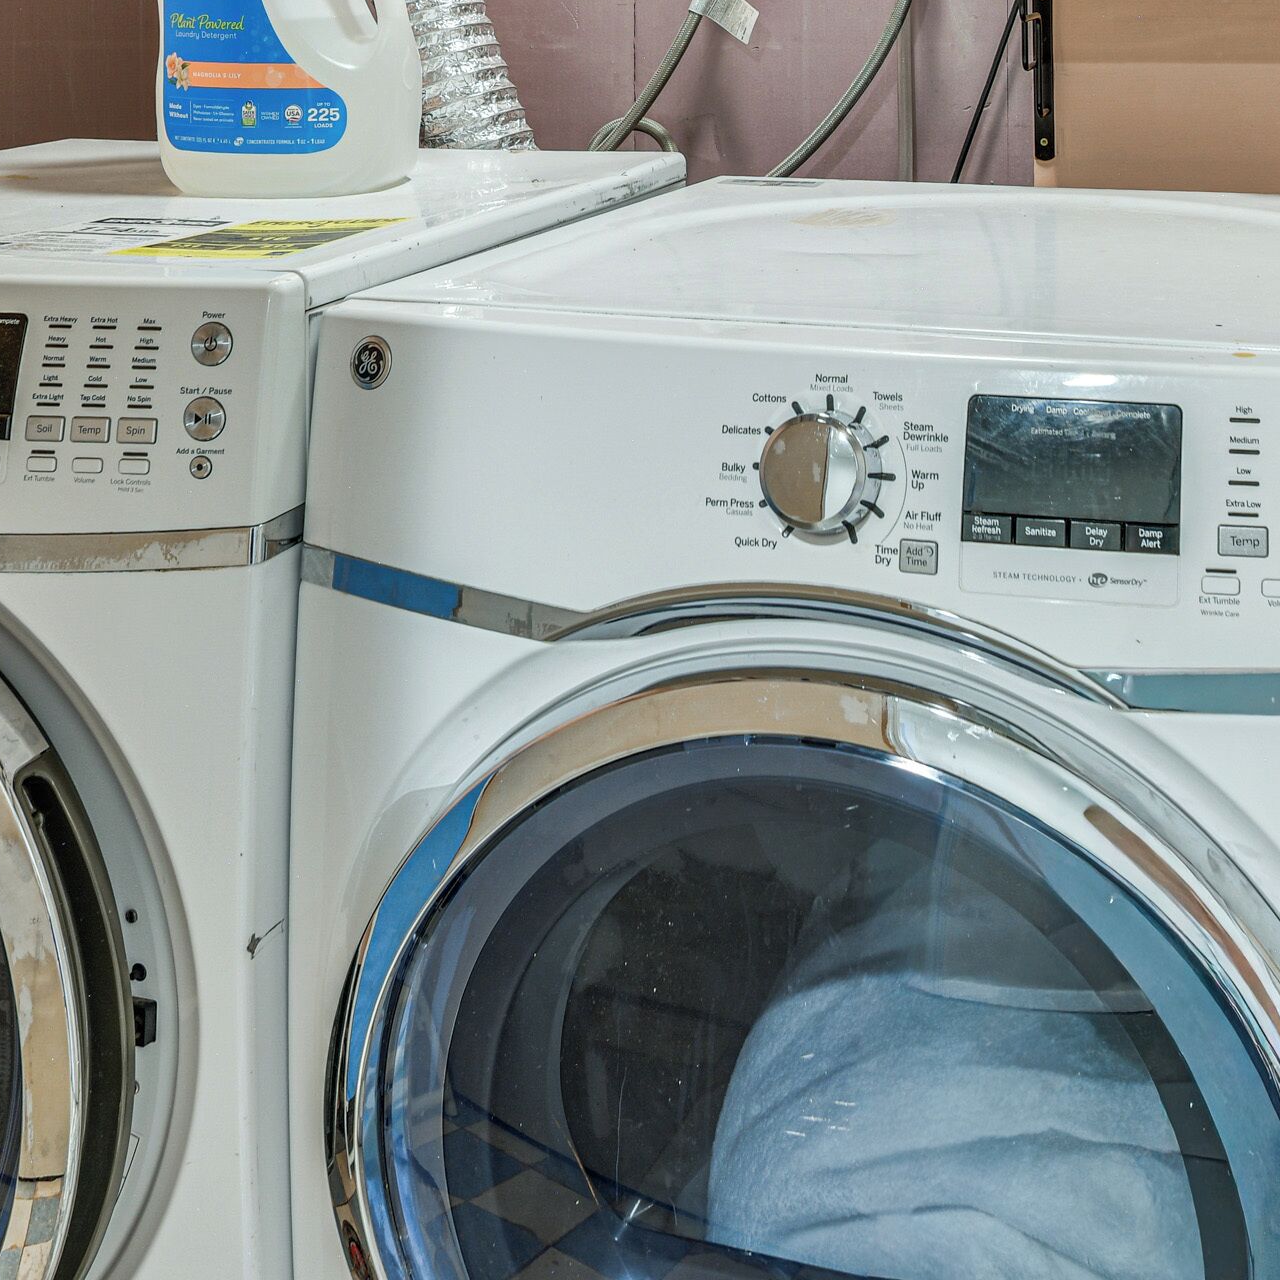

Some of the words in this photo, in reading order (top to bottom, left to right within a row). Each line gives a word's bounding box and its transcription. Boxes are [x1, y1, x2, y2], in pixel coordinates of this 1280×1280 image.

[170, 12, 196, 28] Plant
[198, 14, 244, 30] Powered
[176, 30, 200, 40] Laundry
[202, 30, 236, 40] Detergent
[308, 108, 340, 122] 225
[60, 316, 78, 324] Heavy
[202, 311, 226, 319] Power
[43, 374, 58, 382] Light
[815, 374, 848, 384] Normal
[180, 387, 200, 395] Start
[209, 388, 232, 396] Pause
[830, 384, 854, 394] Loads
[80, 394, 92, 402] Tap
[137, 396, 151, 404] Spin
[752, 393, 786, 403] Cottons
[873, 392, 902, 402] Towels
[879, 402, 904, 411] Sheets
[1011, 404, 1034, 414] Drying
[1046, 406, 1068, 416] Damp
[1236, 405, 1252, 415] High
[36, 424, 52, 433] Soil
[78, 426, 101, 435] Temp
[126, 426, 146, 436] Spin
[722, 425, 762, 435] Delicates
[903, 422, 934, 432] Steam
[903, 432, 948, 442] Dewrinkle
[1230, 436, 1260, 445] Medium
[196, 448, 224, 456] Garment
[906, 444, 919, 452] Full
[920, 444, 942, 453] Loads
[722, 462, 746, 474] Bulky
[1236, 467, 1252, 476] Low
[74, 476, 95, 484] Volume
[719, 474, 747, 483] Bedding
[912, 470, 939, 480] Warm
[912, 480, 924, 490] Up
[706, 498, 726, 508] Perm
[730, 498, 754, 508] Press
[1226, 499, 1244, 508] Extra
[1246, 500, 1262, 509] Low
[726, 508, 753, 516] Casuals
[906, 511, 918, 521] Air
[920, 511, 942, 522] Fluff
[974, 516, 1000, 526] Steam
[904, 522, 914, 530] No
[916, 522, 934, 532] Heat
[1025, 526, 1056, 537] Sanitize
[1086, 527, 1108, 538] Delay
[1138, 528, 1163, 539] Damp
[734, 537, 760, 548] Quick
[762, 538, 778, 550] Dry
[1090, 537, 1104, 548] Dry
[1140, 538, 1161, 548] Alert
[1230, 536, 1260, 548] Temp
[875, 544, 898, 556] Time
[906, 546, 923, 556] Add
[875, 555, 892, 567] Dry
[906, 556, 928, 567] Time
[993, 572, 1020, 580] STEAM
[1023, 573, 1076, 583] TECHNOLOGY
[1198, 596, 1211, 605] Ext
[1212, 596, 1240, 606] Tumble
